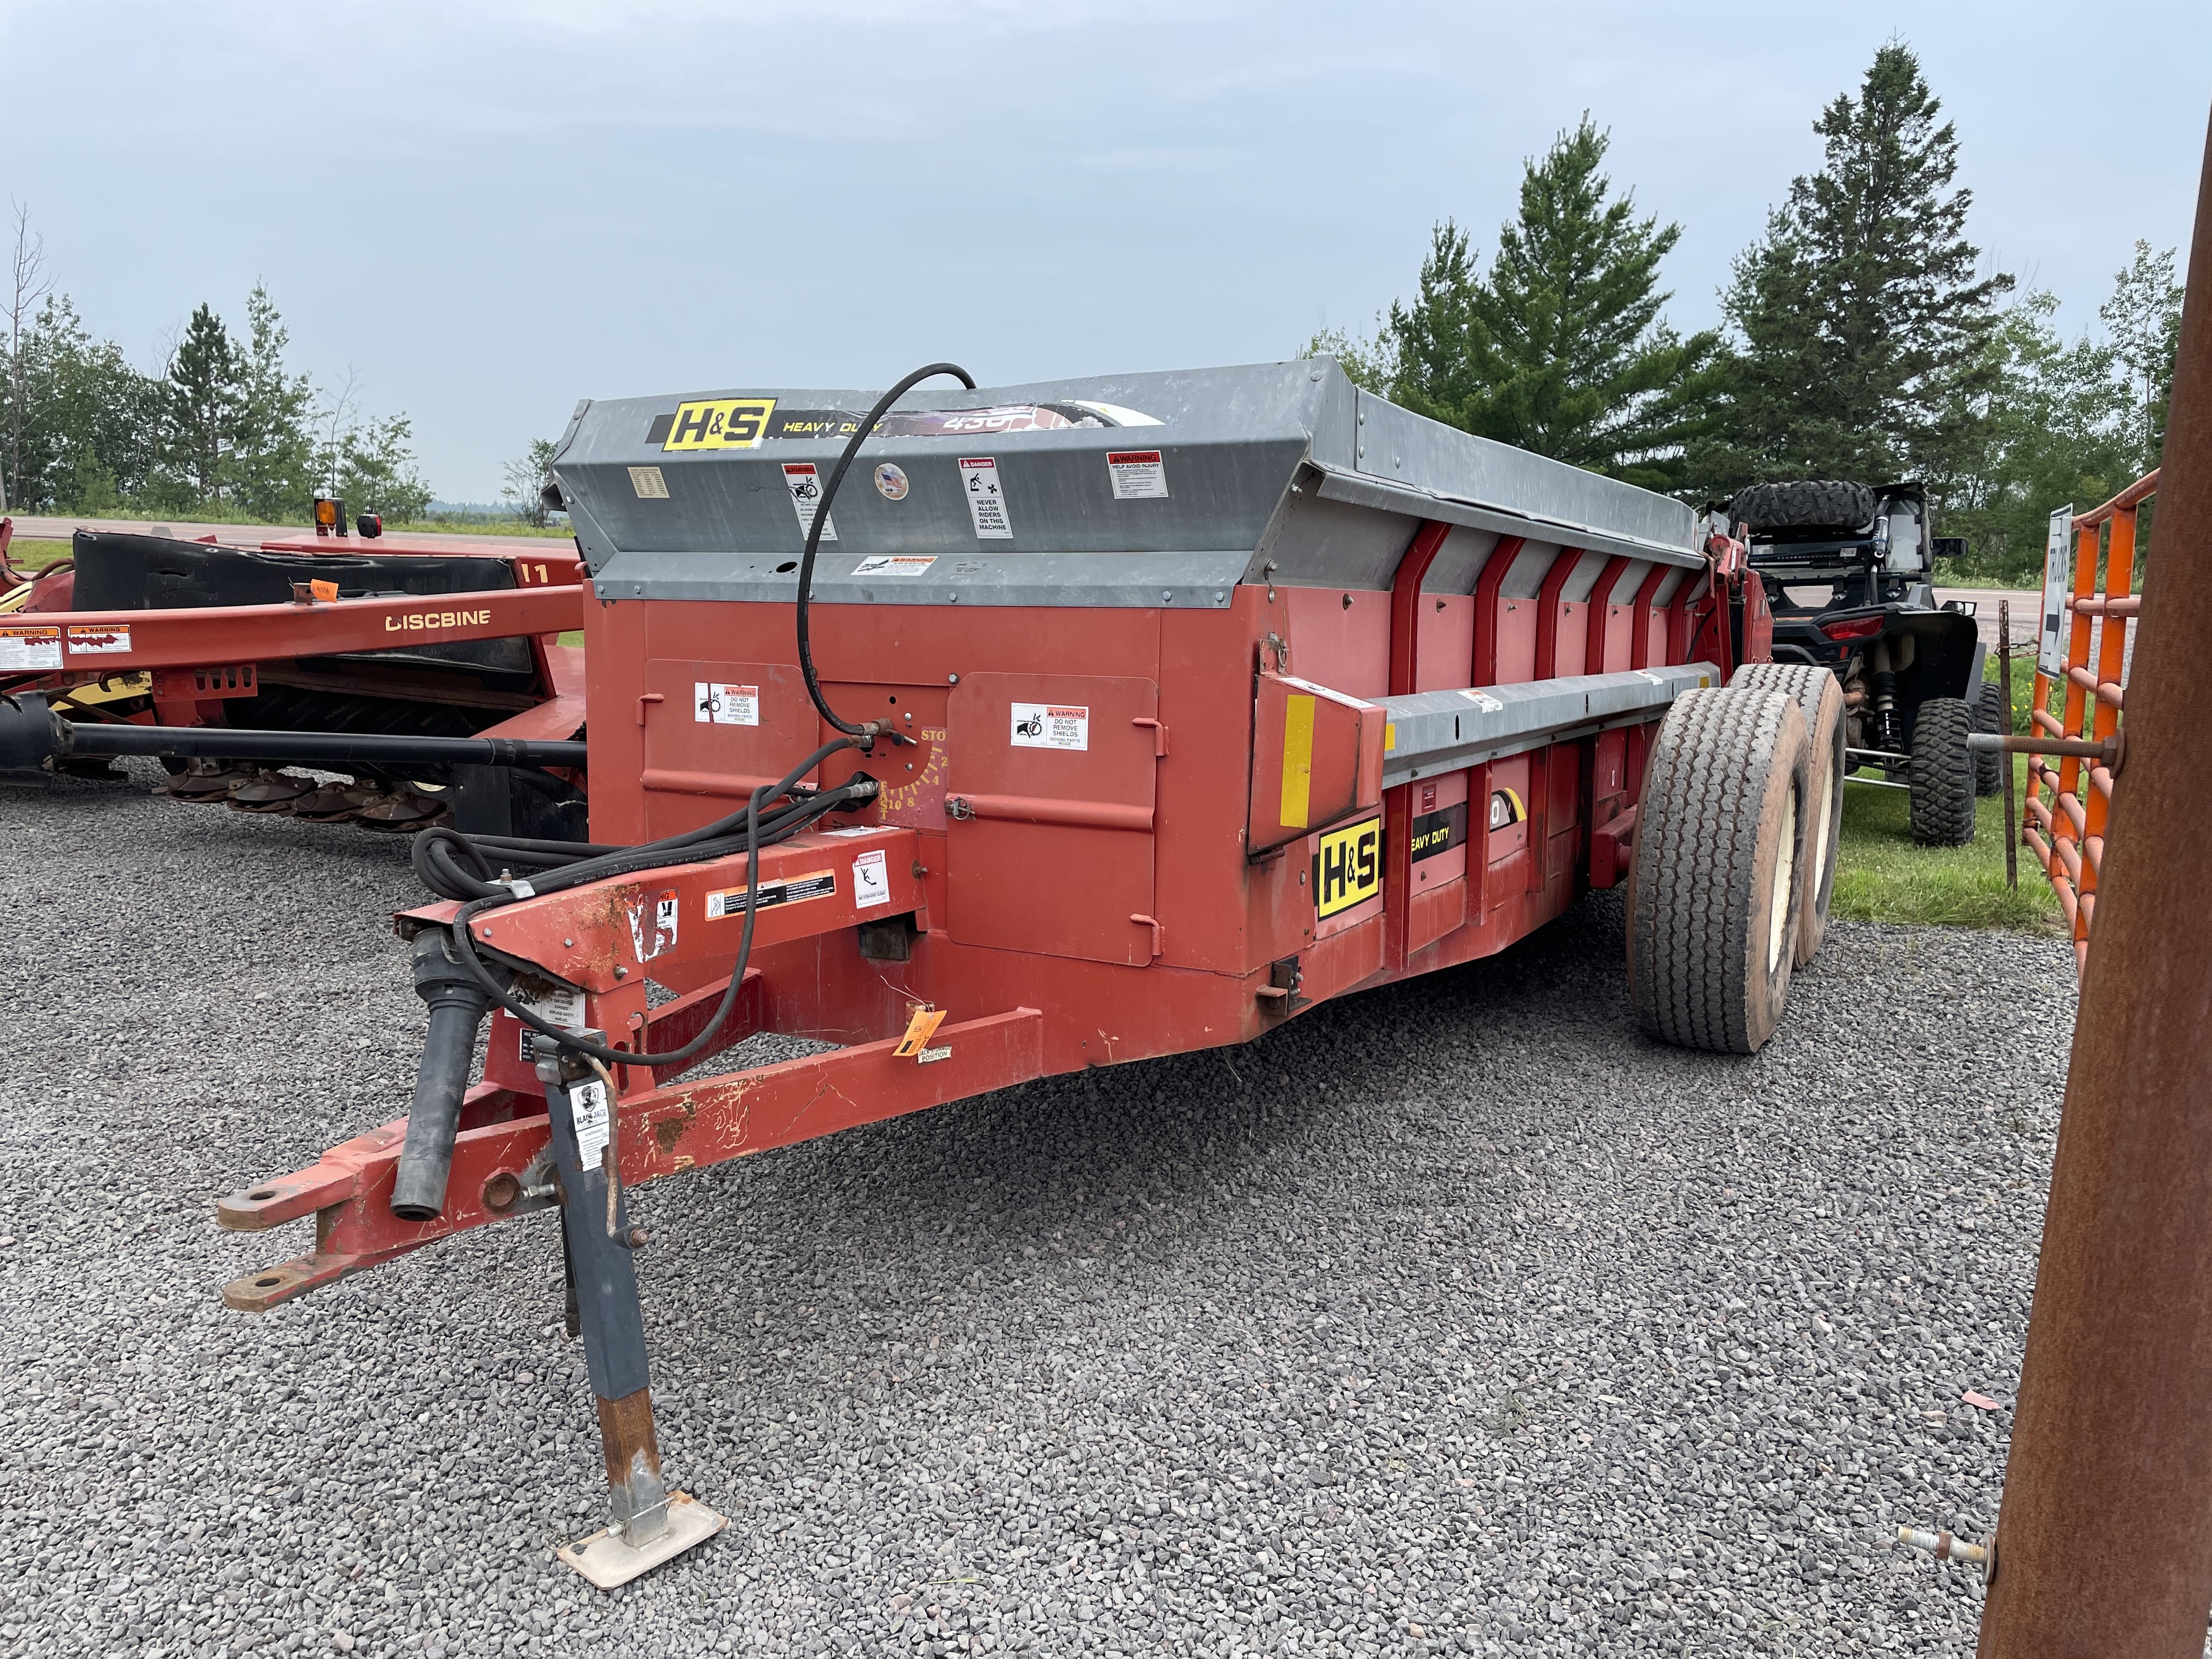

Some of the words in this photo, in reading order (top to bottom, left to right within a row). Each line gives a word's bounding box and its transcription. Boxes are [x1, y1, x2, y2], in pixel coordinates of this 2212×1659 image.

[673, 407, 765, 443] H&S
[783, 422, 834, 432] HEAVY
[839, 423, 884, 432] DUY
[921, 730, 946, 741] STO
[941, 757, 948, 768] 2
[933, 775, 940, 786] 4
[880, 781, 888, 820] FAST
[888, 799, 902, 810] 10
[907, 797, 916, 807] 8
[1489, 800, 1499, 825] 0
[860, 855, 882, 864] DANGER
[1324, 831, 1375, 905] H&S
[1412, 833, 1430, 852] EAVY
[1431, 827, 1449, 845] DUTY
[918, 1048, 930, 1057] JACK
[922, 1051, 947, 1061] POSITION
